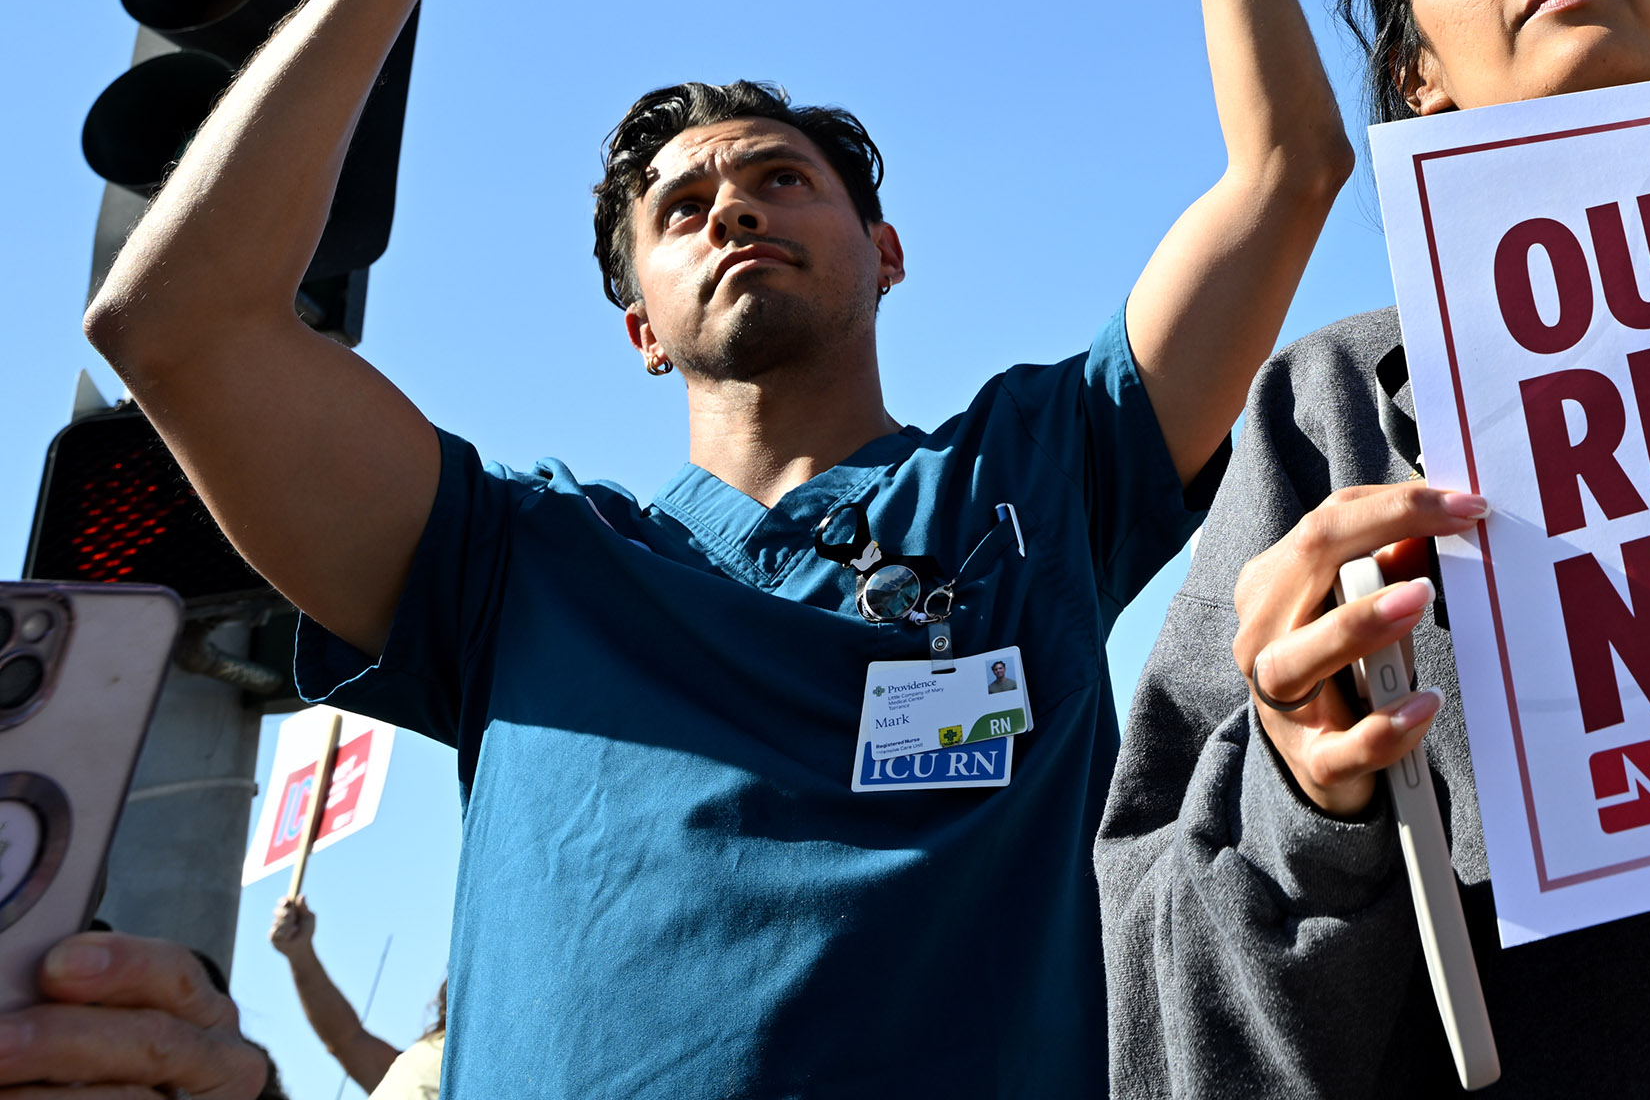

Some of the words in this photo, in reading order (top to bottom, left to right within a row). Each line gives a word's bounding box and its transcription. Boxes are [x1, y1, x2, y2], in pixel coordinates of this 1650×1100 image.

[888, 680, 936, 694] Providence
[875, 713, 910, 730] Mark
[990, 716, 1012, 735] RN
[876, 738, 904, 749] Registered
[904, 737, 920, 745] Nurse
[870, 752, 939, 779] ICU
[946, 751, 999, 776] RN
[273, 776, 313, 847] IC
